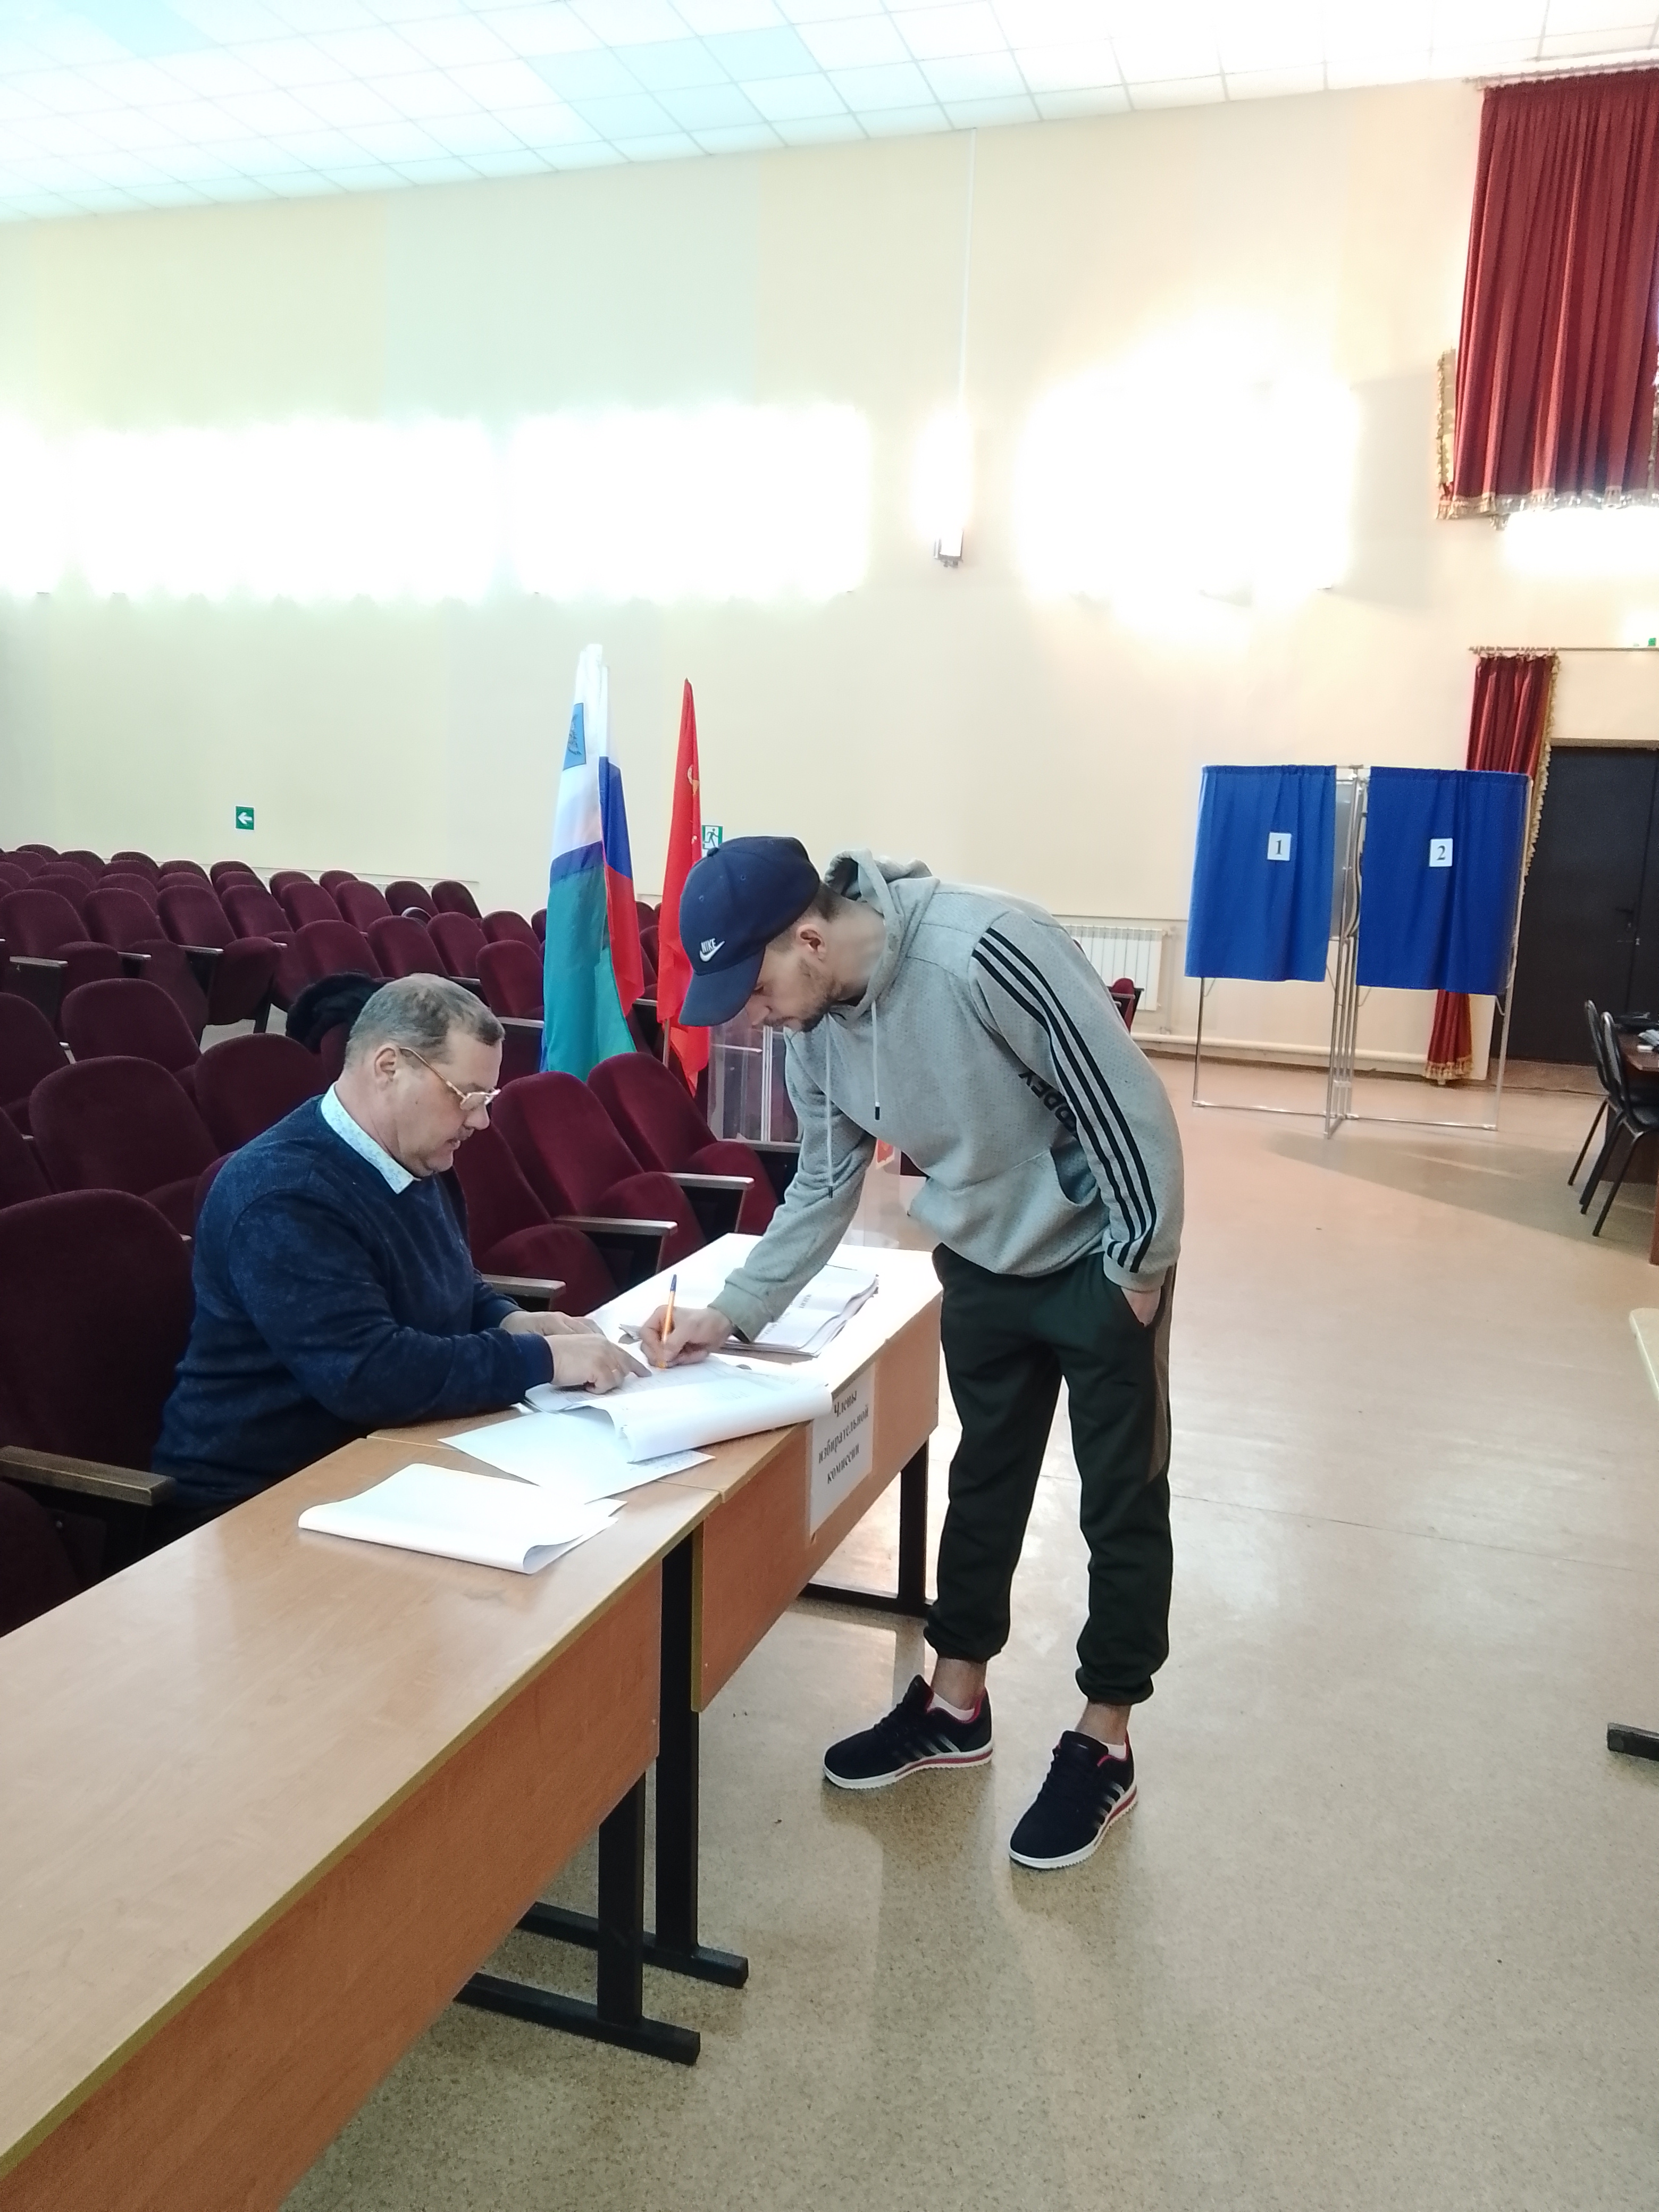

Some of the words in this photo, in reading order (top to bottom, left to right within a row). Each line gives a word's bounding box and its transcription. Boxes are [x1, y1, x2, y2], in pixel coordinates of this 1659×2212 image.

[1276, 840, 1282, 855] 1
[1436, 845, 1446, 861] 2
[700, 938, 716, 953] NIKE
[833, 1390, 857, 1418] Члены
[818, 1403, 869, 1464] избирательной
[827, 1443, 860, 1484] комиссии
